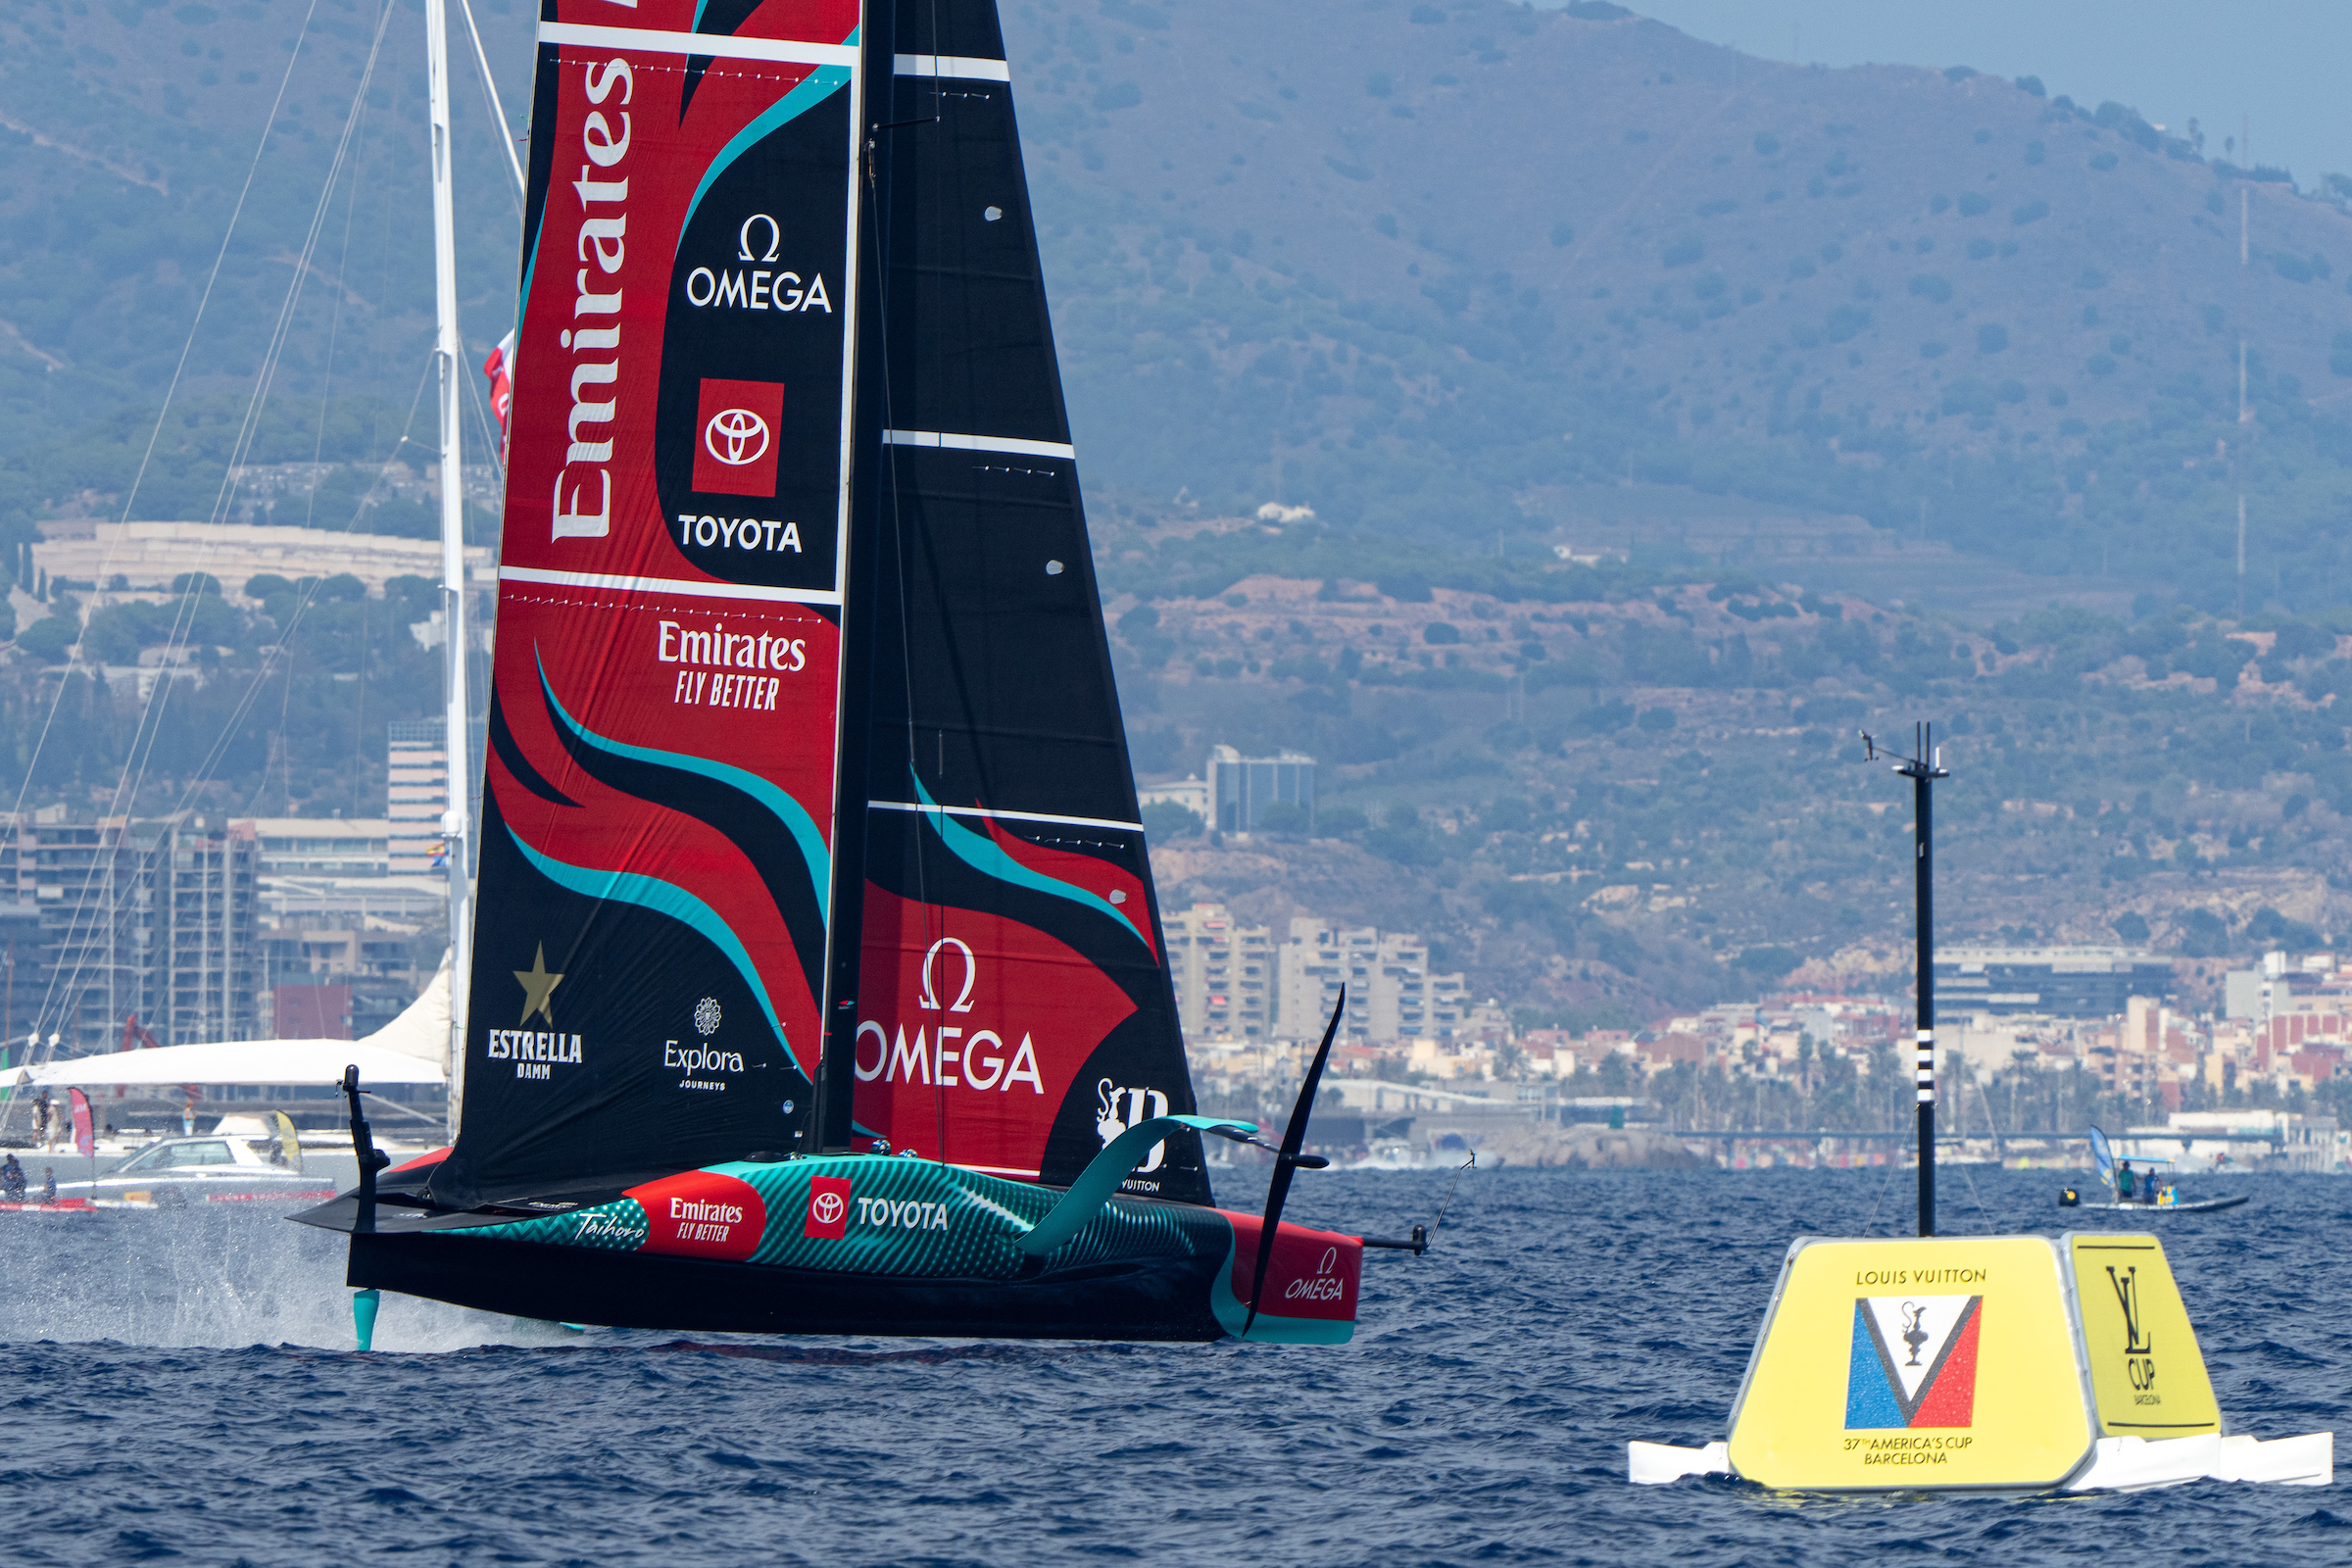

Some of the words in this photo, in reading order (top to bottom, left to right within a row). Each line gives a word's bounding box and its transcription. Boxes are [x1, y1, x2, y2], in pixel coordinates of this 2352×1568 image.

[551, 57, 634, 544] Emirates
[686, 267, 832, 314] OMEGA
[678, 514, 803, 554] TOYOTA
[659, 620, 806, 672] Emirates
[674, 670, 708, 705] FLY
[709, 673, 780, 711] BETTER
[488, 1028, 582, 1063] ESTRELLA
[663, 1039, 744, 1076] Explora
[855, 1020, 1045, 1095] OMEGA
[516, 1064, 551, 1080] DAMM
[678, 1079, 726, 1092] JOURNEYS
[1121, 1179, 1160, 1192] VUITTON
[574, 1212, 646, 1241] Taihoro
[669, 1197, 743, 1225] Emirates
[858, 1197, 948, 1231] TOYOTA
[676, 1222, 695, 1241] FLY
[695, 1224, 730, 1243] BETTER
[1285, 1278, 1345, 1300] OMEGA
[1856, 1270, 1907, 1285] LOUIS
[1914, 1268, 1987, 1284] VUITTON
[2128, 1357, 2155, 1391] CUP
[1864, 1451, 1948, 1465] BARCELONA
[1870, 1437, 1943, 1449] AMERICA'S
[1945, 1437, 1973, 1448] CUP
